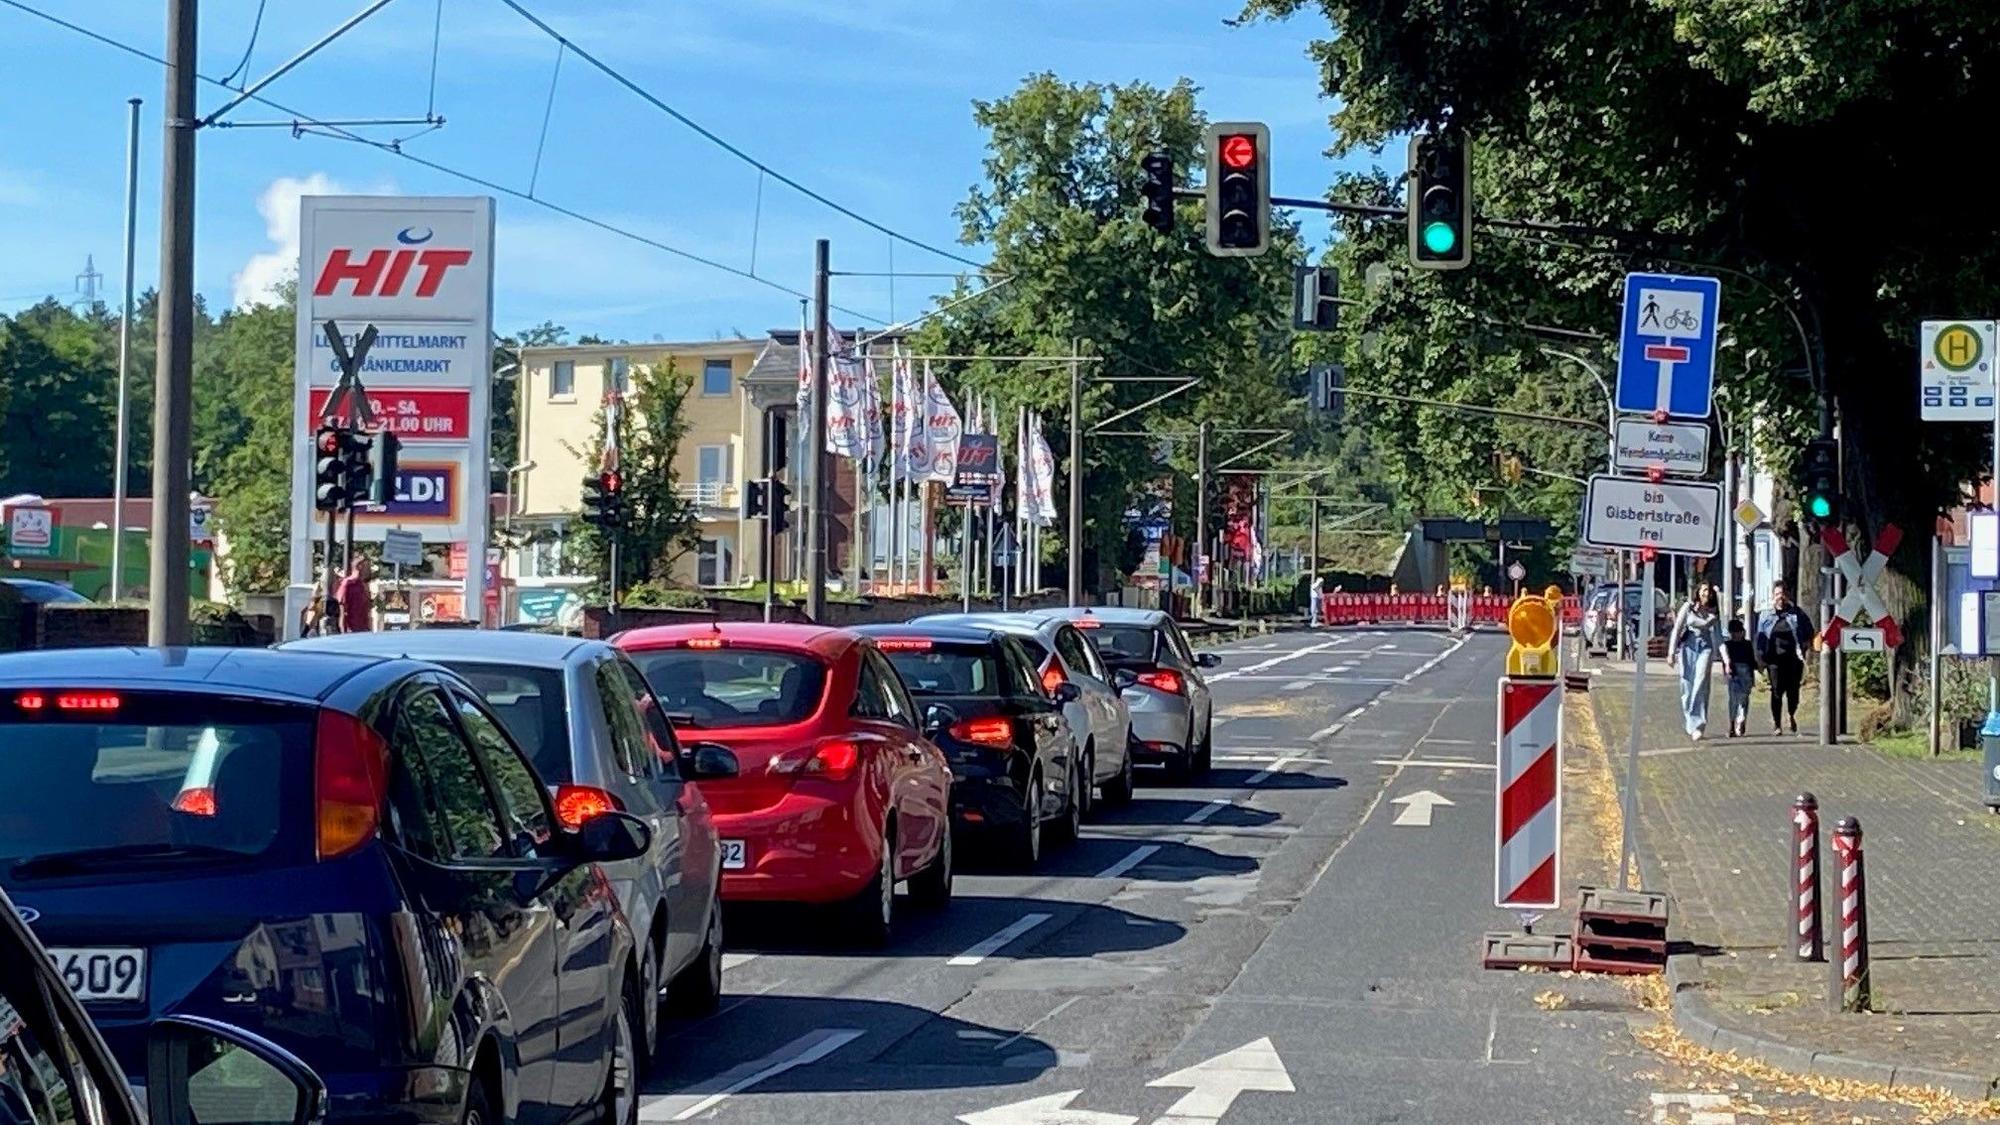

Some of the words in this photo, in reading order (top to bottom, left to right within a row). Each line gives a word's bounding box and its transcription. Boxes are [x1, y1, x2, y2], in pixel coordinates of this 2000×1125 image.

[313, 248, 473, 297] HIT
[1948, 334, 1969, 361] H
[423, 418, 453, 432] UHR
[928, 414, 957, 427] HIT
[394, 476, 445, 502] LDI
[1643, 489, 1664, 503] bis
[1605, 505, 1700, 526] Gisbertstraße
[1639, 526, 1663, 541] frei
